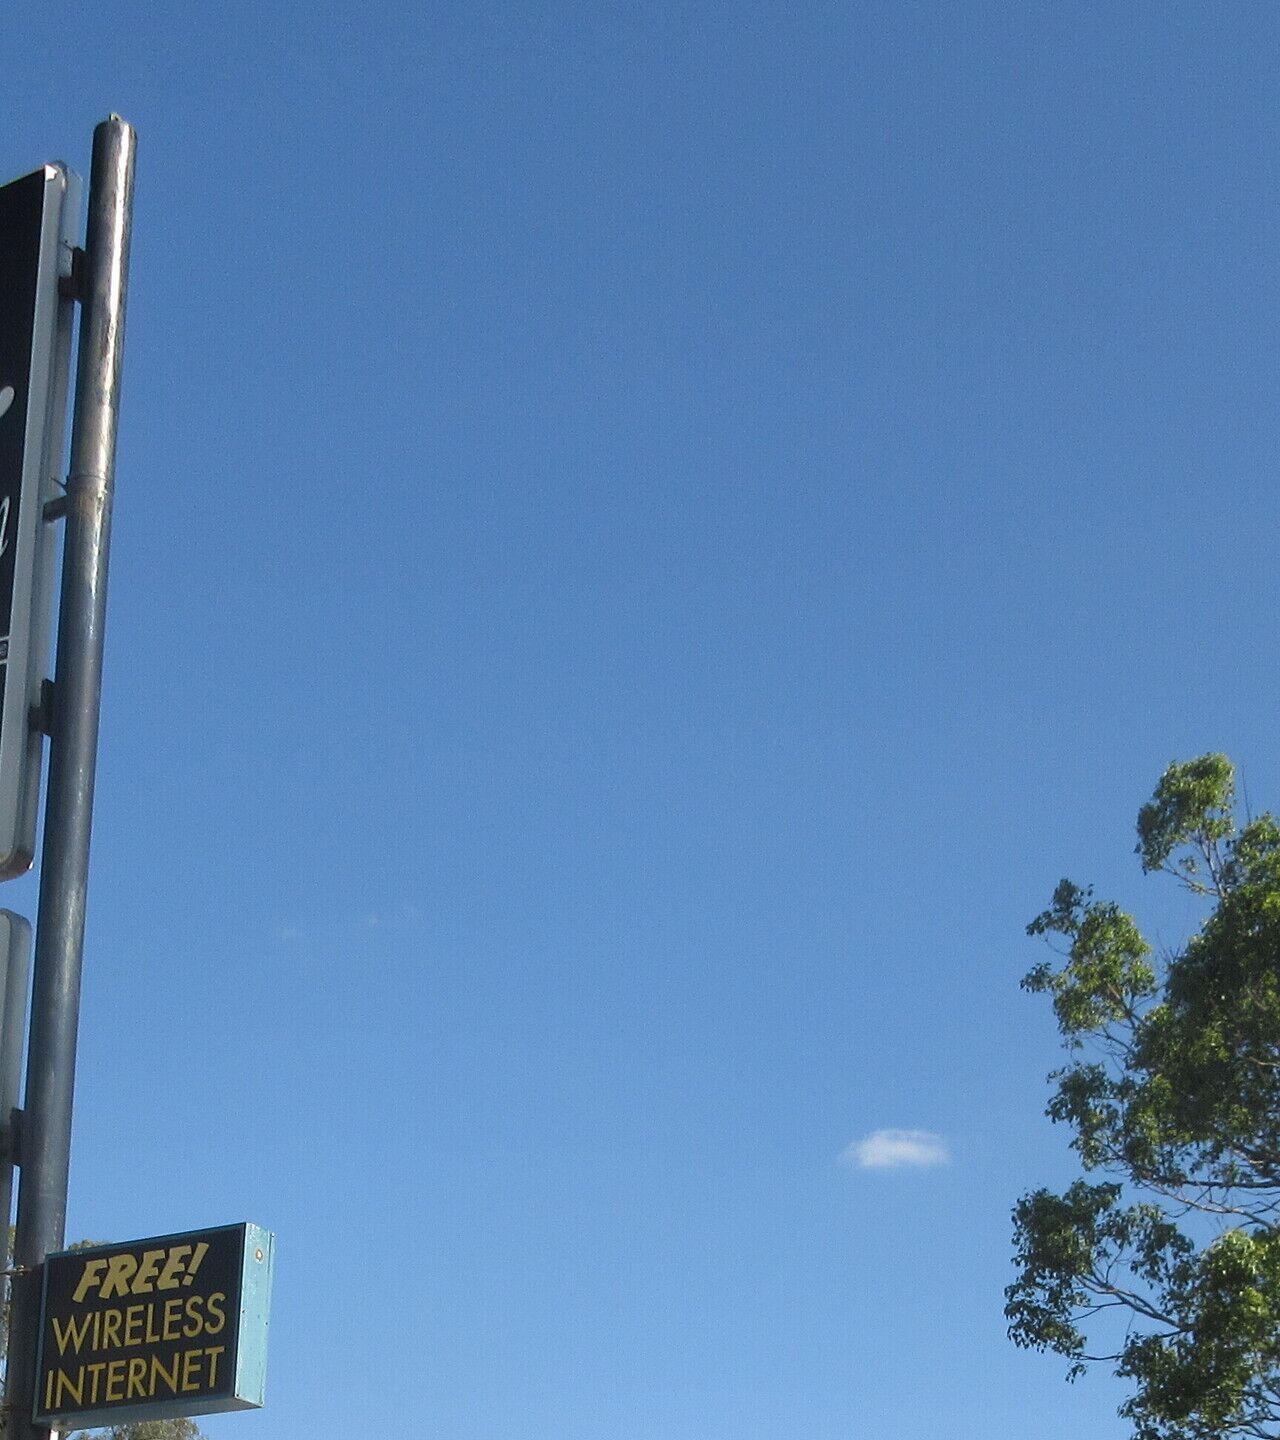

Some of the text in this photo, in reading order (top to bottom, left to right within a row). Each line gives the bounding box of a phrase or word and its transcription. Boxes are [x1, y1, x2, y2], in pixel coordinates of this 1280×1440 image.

[73, 1242, 210, 1303] FREE!
[52, 1293, 226, 1357] WIRELESS
[45, 1345, 225, 1410] INTERNET
